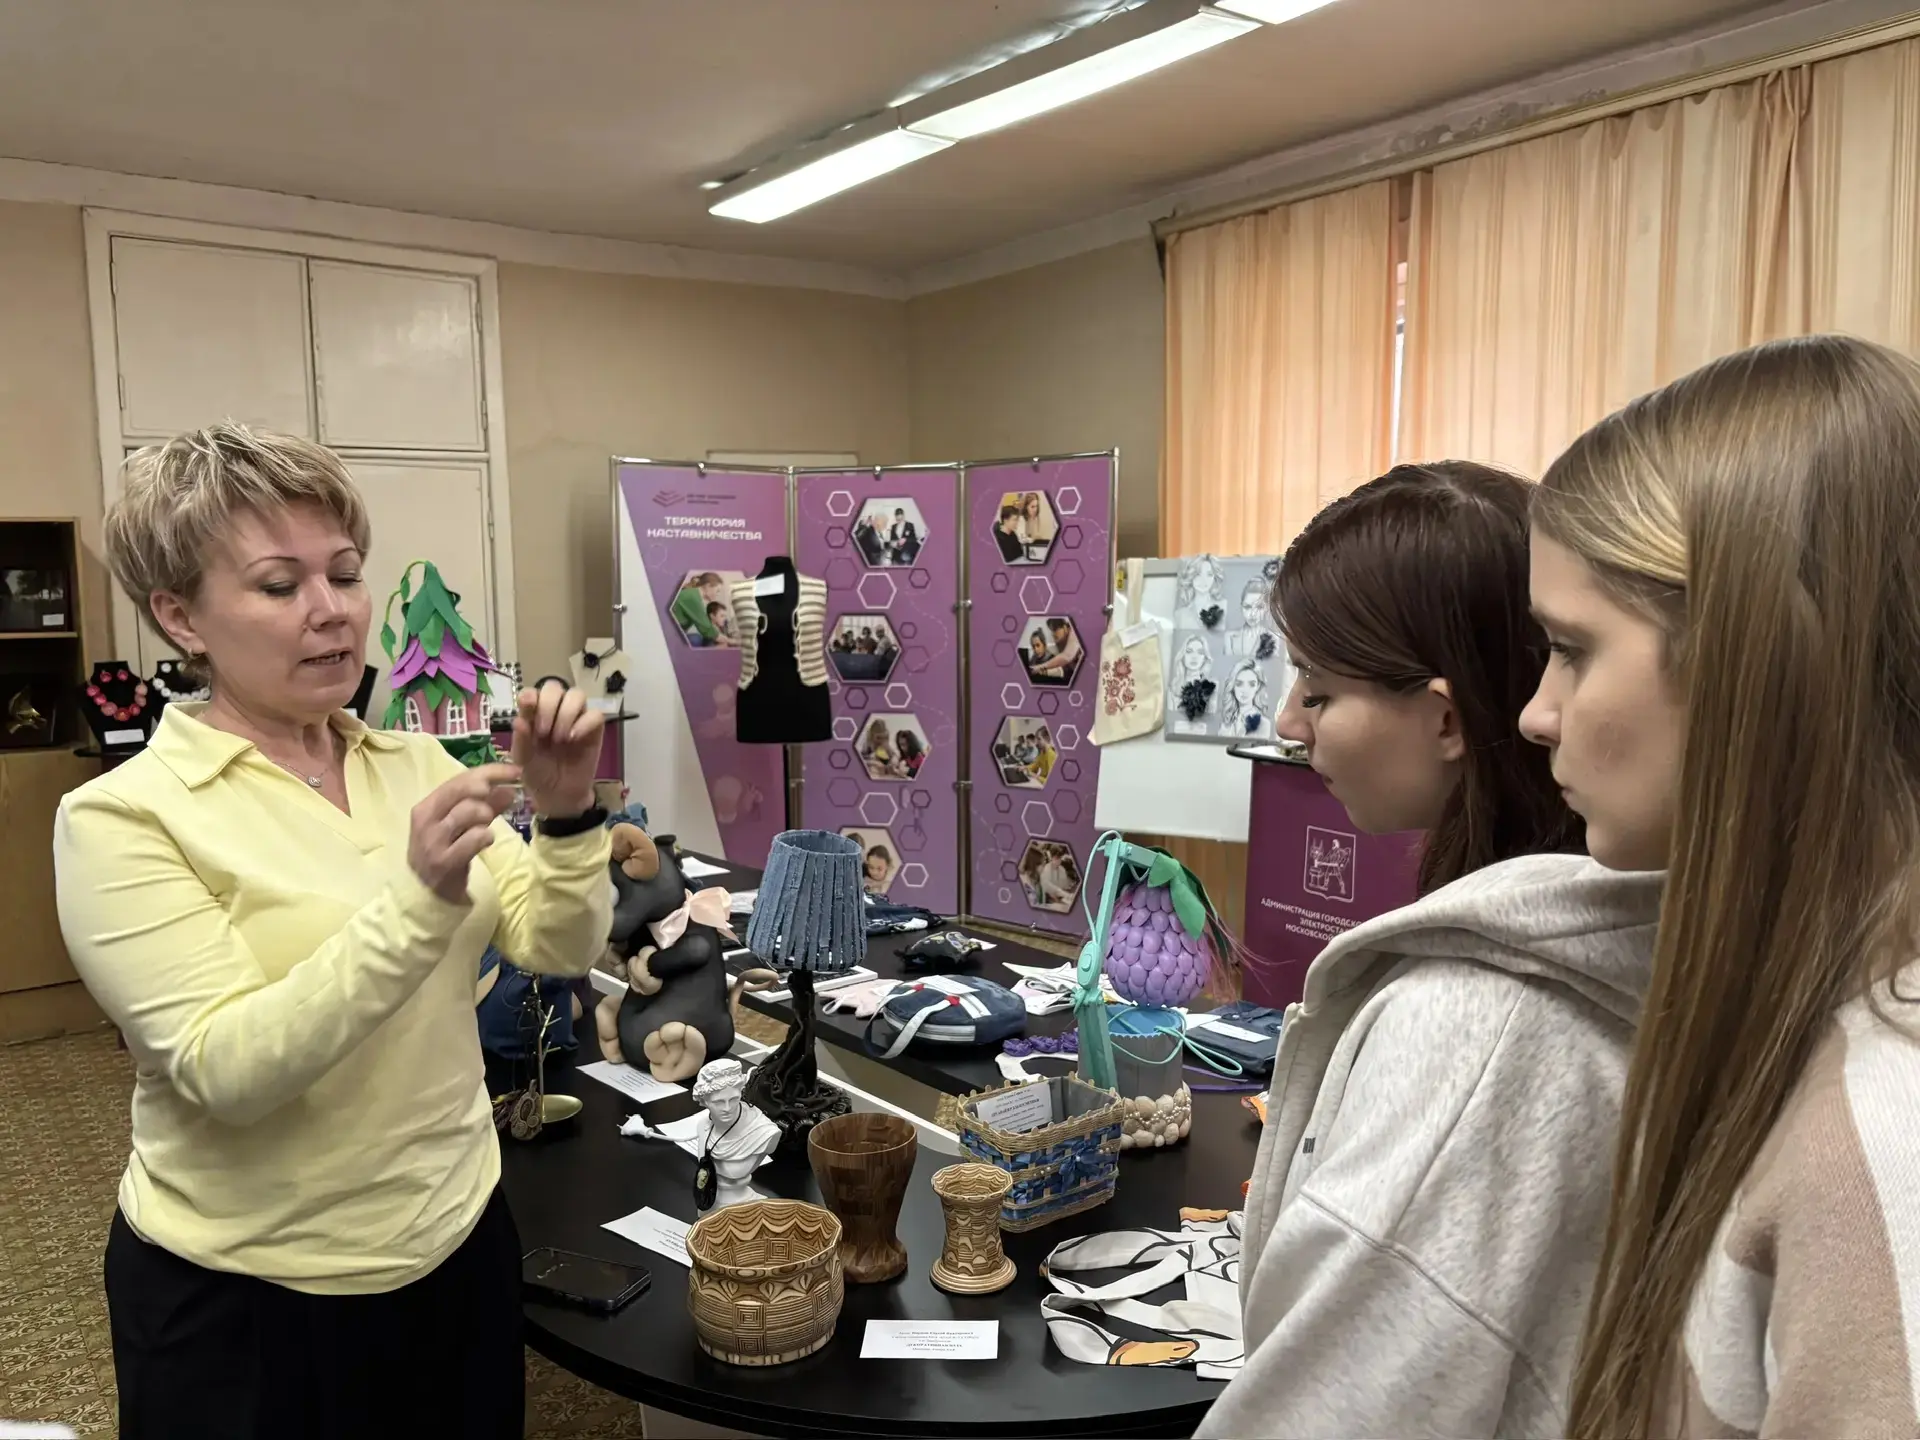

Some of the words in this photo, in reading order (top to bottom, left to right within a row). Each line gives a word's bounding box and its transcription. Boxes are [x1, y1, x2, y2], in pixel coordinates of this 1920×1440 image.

[664, 516, 746, 528] ТЕРРИТОРИЯ
[647, 528, 762, 541] НАСТАВНИЧЕСТВА
[1260, 897, 1320, 919] АДМИНИСТРАЦИЯ
[1299, 917, 1351, 934] ЭЛЕКТРОСТА
